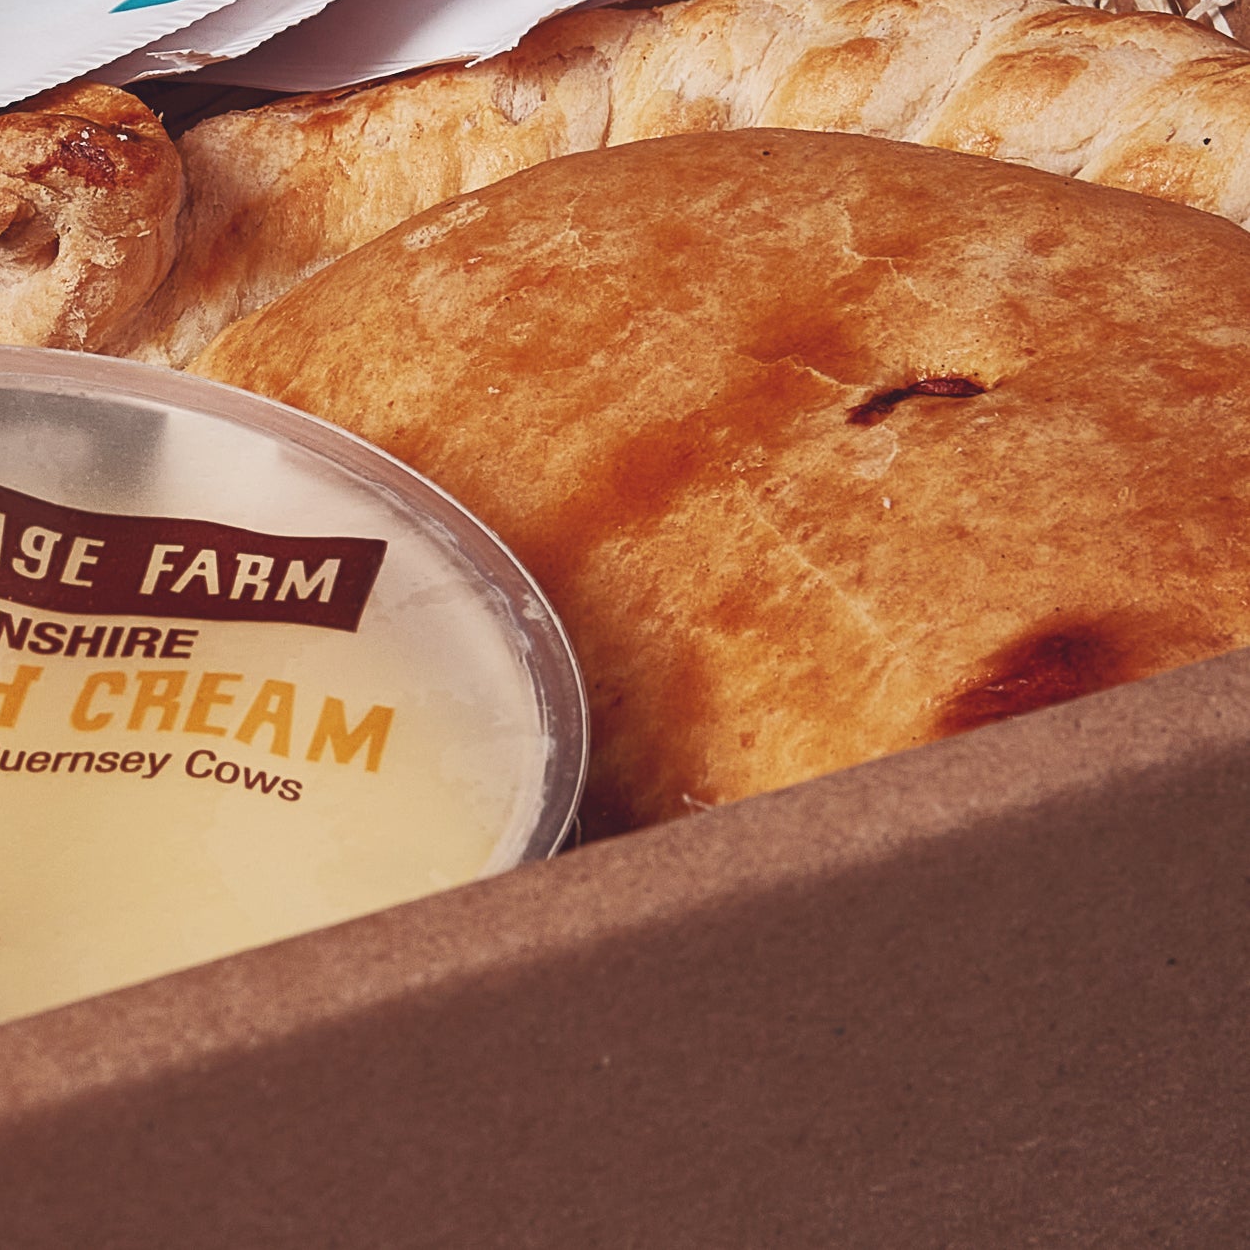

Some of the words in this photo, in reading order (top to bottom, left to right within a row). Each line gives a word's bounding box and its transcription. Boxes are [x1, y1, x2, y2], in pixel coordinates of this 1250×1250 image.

[139, 544, 342, 603] FARM
[69, 670, 396, 774] CREAM
[184, 749, 304, 802] Cows
